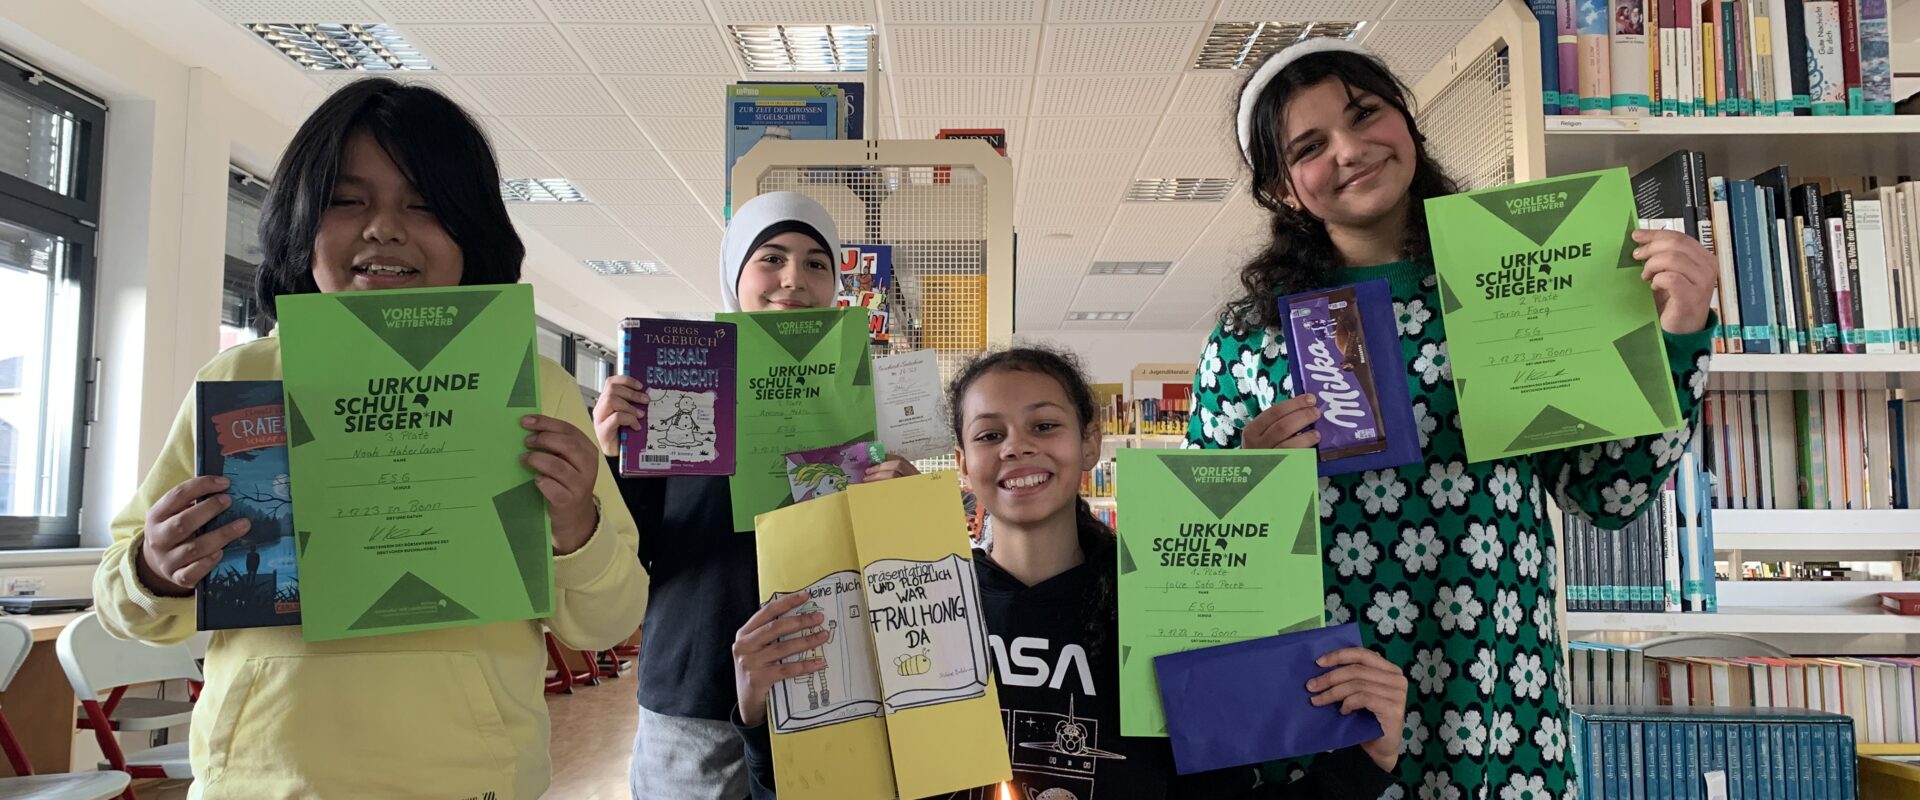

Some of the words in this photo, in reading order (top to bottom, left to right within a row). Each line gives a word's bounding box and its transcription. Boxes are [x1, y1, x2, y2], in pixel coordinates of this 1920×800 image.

[754, 113, 807, 121] SEGELSCHIFFE
[1505, 192, 1557, 210] VORLESE
[1509, 201, 1565, 215] WETTBEWERB
[1844, 193, 1852, 213] Jahre
[1846, 230, 1855, 242] der
[1500, 242, 1592, 270] URKUNDE
[1848, 242, 1857, 259] Welt
[1849, 259, 1858, 270] Die
[1475, 266, 1535, 288] SCHUL
[381, 306, 444, 320] VORLESE
[385, 317, 453, 329] WETTBEWERB
[776, 320, 816, 330] VORLESE
[778, 326, 820, 335] WETTBEWERB
[663, 326, 699, 335] GREGS
[715, 328, 726, 338] 13
[643, 333, 718, 347] TAGEBUCH
[656, 347, 709, 366] EISKALT
[646, 366, 719, 388] ERWISCHT!
[768, 363, 836, 378] URKUNDE
[368, 373, 480, 396] URKUNDE
[749, 377, 793, 389] SCHUL
[1304, 337, 1366, 428] Milka
[334, 394, 408, 416] SCHUL
[352, 447, 379, 459] Noah
[377, 472, 411, 485] ESG
[1191, 466, 1240, 476] VORLESE
[1179, 523, 1269, 538] URKUNDE
[1152, 538, 1211, 552] SCHUL
[835, 578, 861, 596] Buch
[872, 580, 895, 595] UND
[896, 586, 928, 603] WAR
[1188, 601, 1215, 612] ESG
[869, 604, 918, 634] FRAU
[920, 595, 966, 626] HONIG
[905, 629, 931, 649] DA
[988, 634, 1097, 696] ASA
